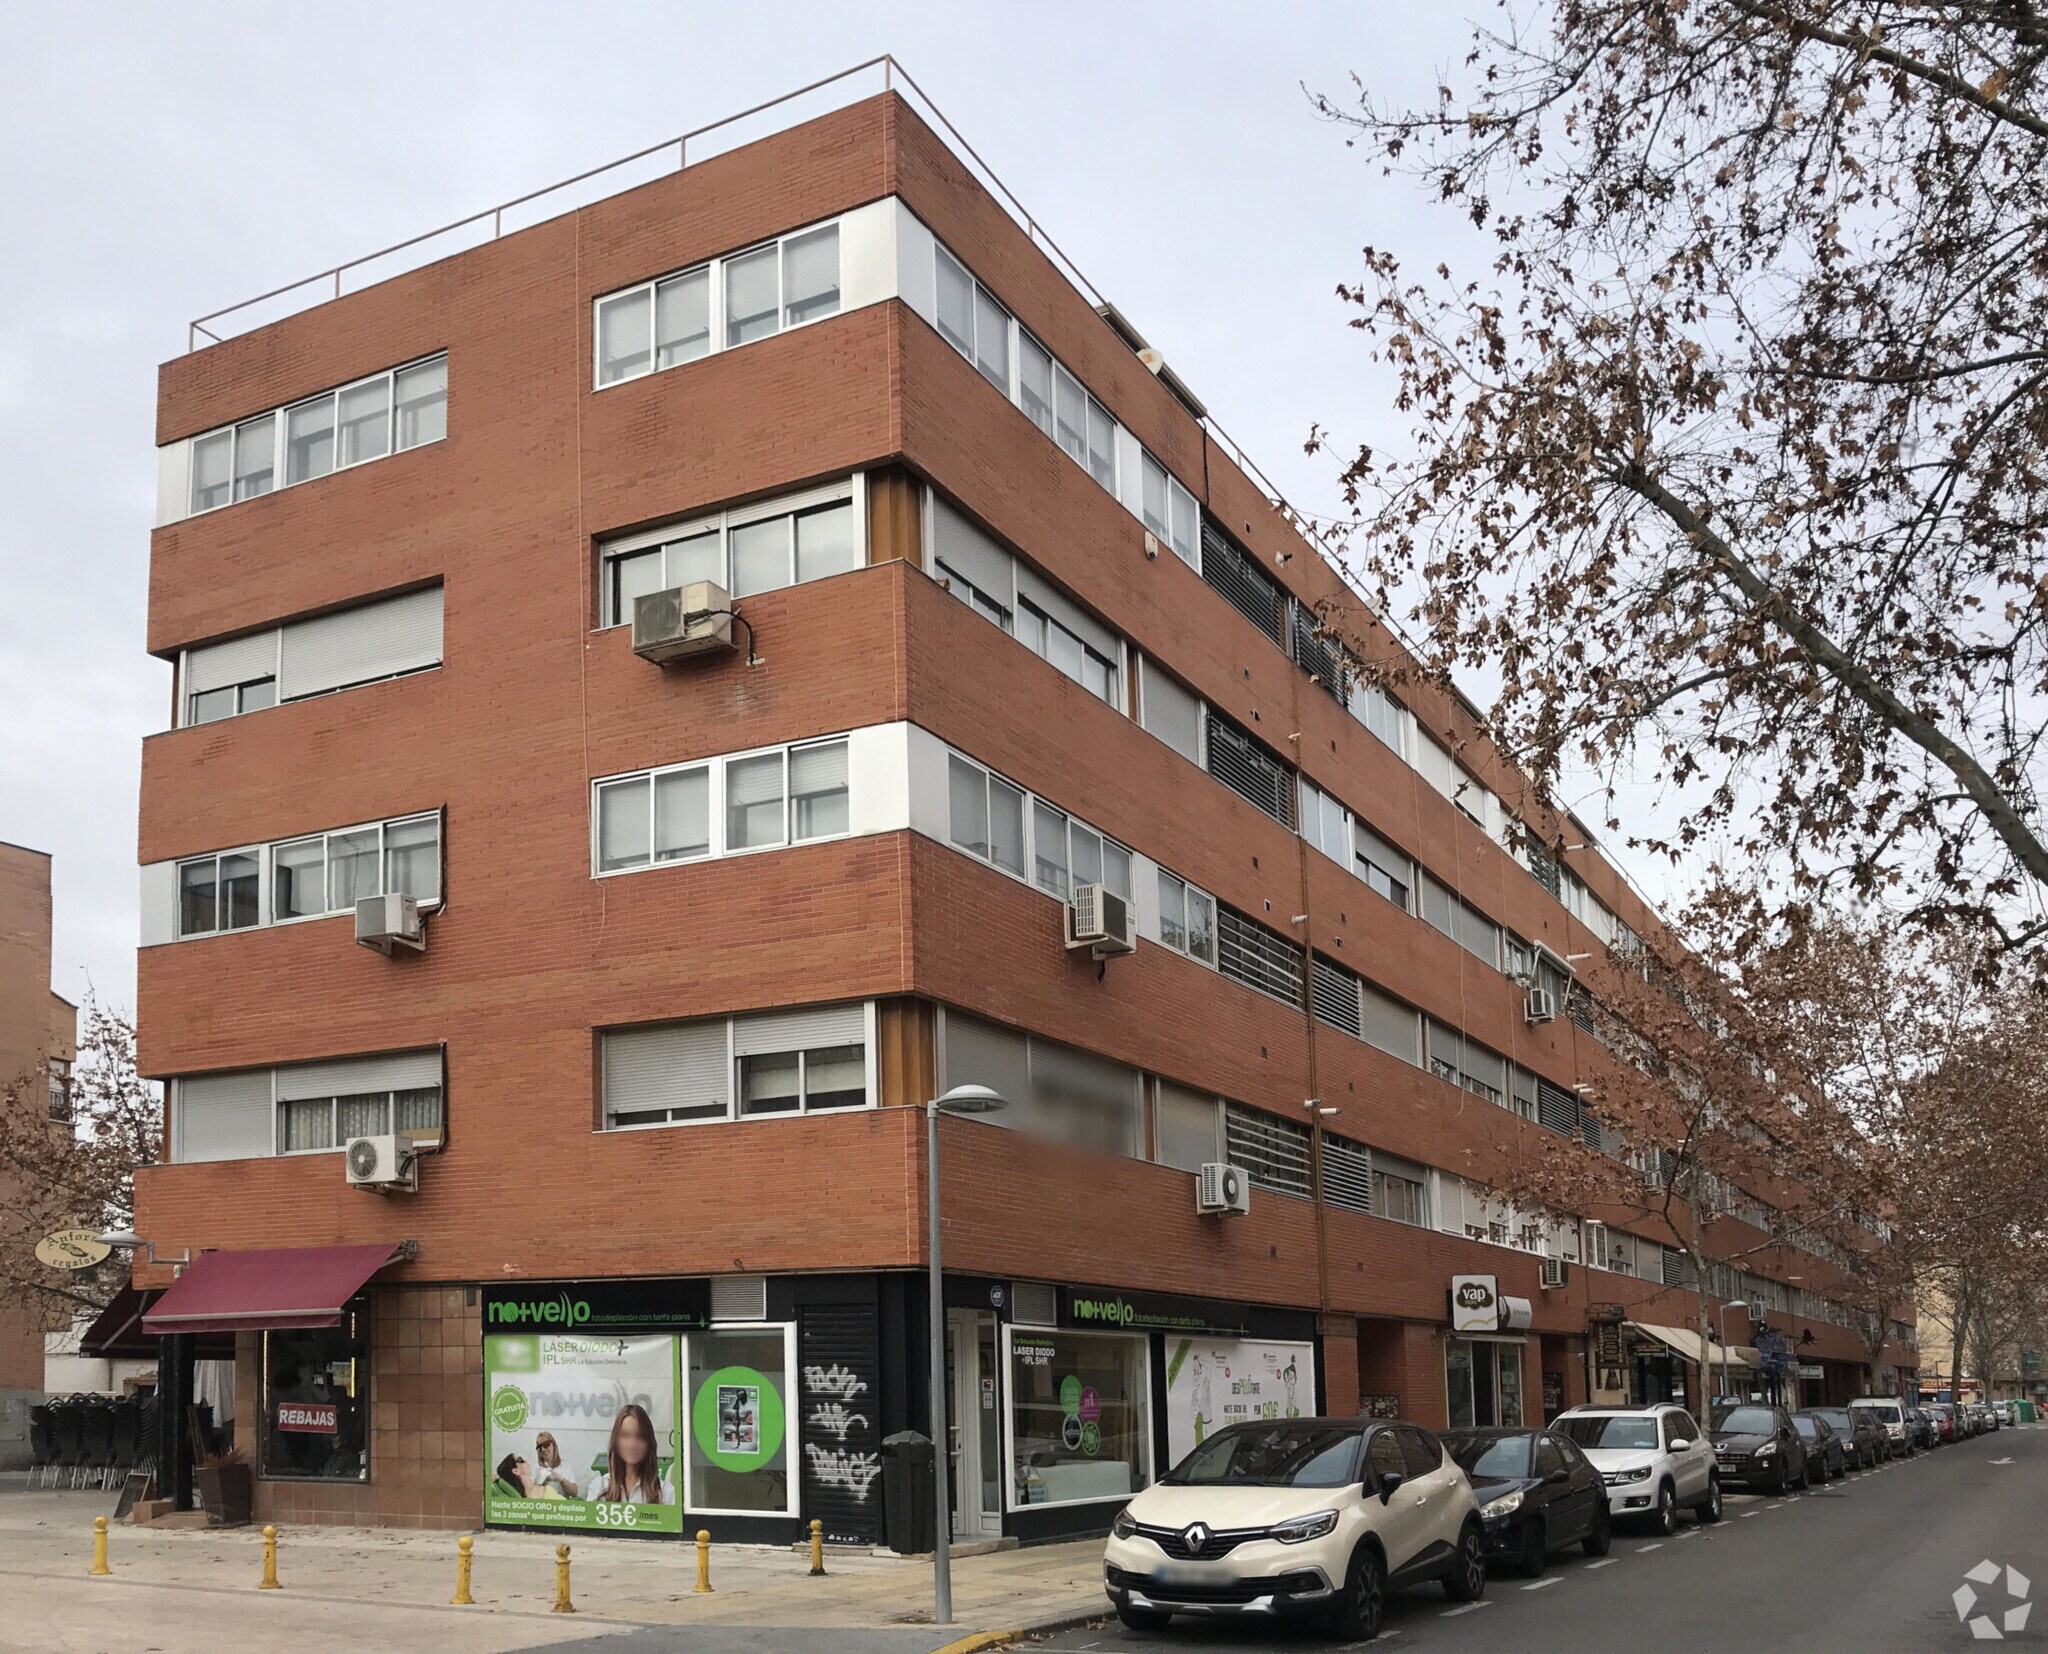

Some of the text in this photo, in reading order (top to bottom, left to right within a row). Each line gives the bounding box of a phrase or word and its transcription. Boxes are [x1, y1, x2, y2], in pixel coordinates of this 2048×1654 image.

[53, 1255, 97, 1268] regalos
[1462, 1288, 1486, 1302] vap
[671, 1313, 691, 1322] plana
[1013, 1346, 1055, 1357] LASER DIODO
[543, 1354, 560, 1365] IPL
[560, 1356, 577, 1365] SHR
[1035, 1356, 1048, 1366] SHR
[494, 1403, 526, 1416] GRATUITA
[279, 1409, 336, 1426] REBAJAS
[491, 1501, 511, 1509] Hazte
[511, 1501, 534, 1510] SOCIO
[535, 1502, 552, 1511] ORO
[552, 1505, 557, 1513] y
[491, 1510, 502, 1518] las
[574, 1515, 587, 1523] por
[595, 1503, 659, 1526] 35€ /mes
